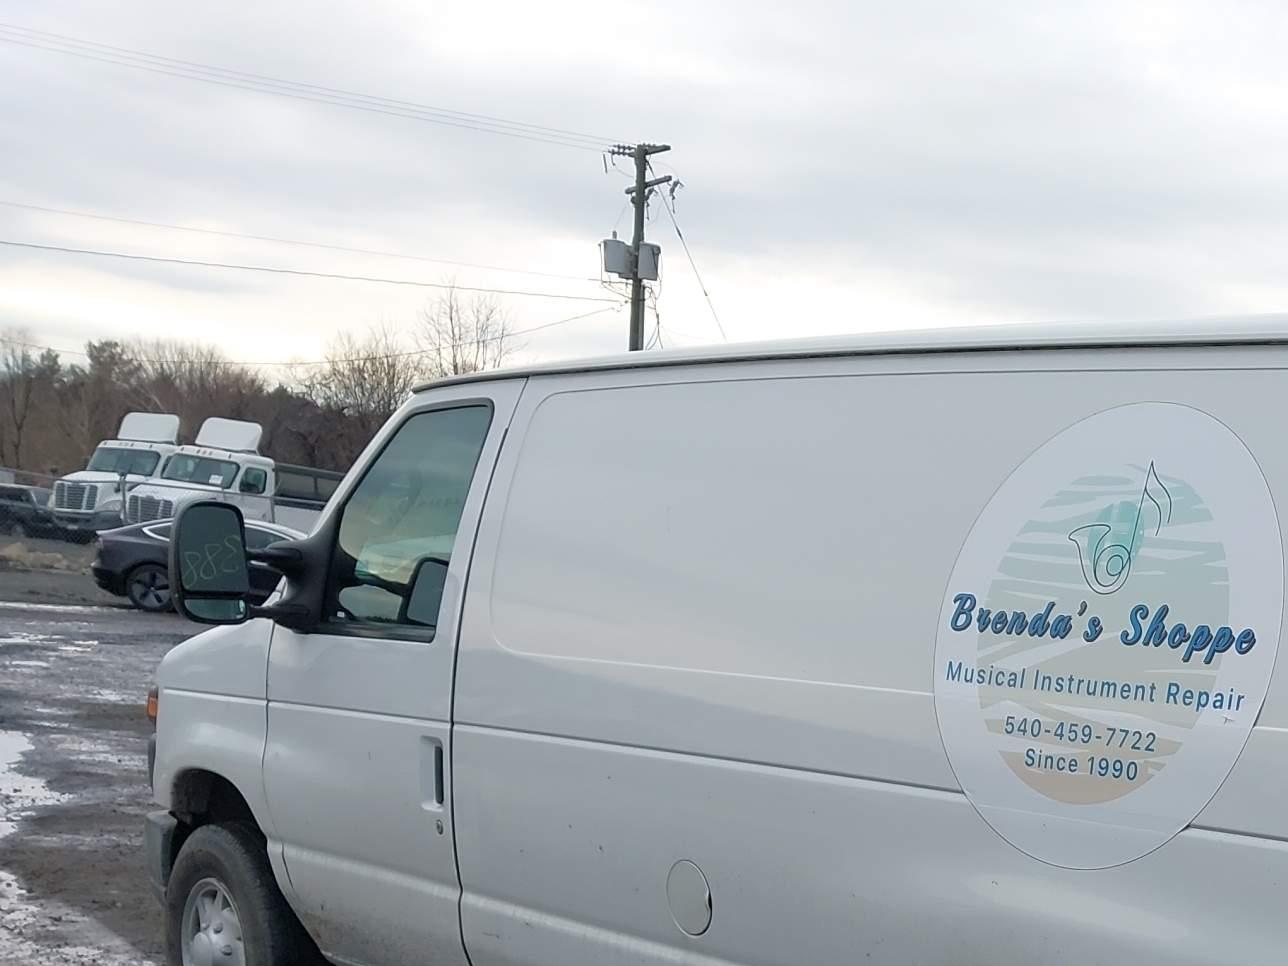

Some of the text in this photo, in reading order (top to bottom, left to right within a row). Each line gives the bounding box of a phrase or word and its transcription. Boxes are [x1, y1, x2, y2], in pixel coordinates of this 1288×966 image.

[949, 593, 1257, 664] Brenda's Shoppe
[946, 661, 1245, 713] Musical Instrument Repair
[1004, 716, 1157, 752] 540-459-7722
[1024, 748, 1138, 781] Since 1990
